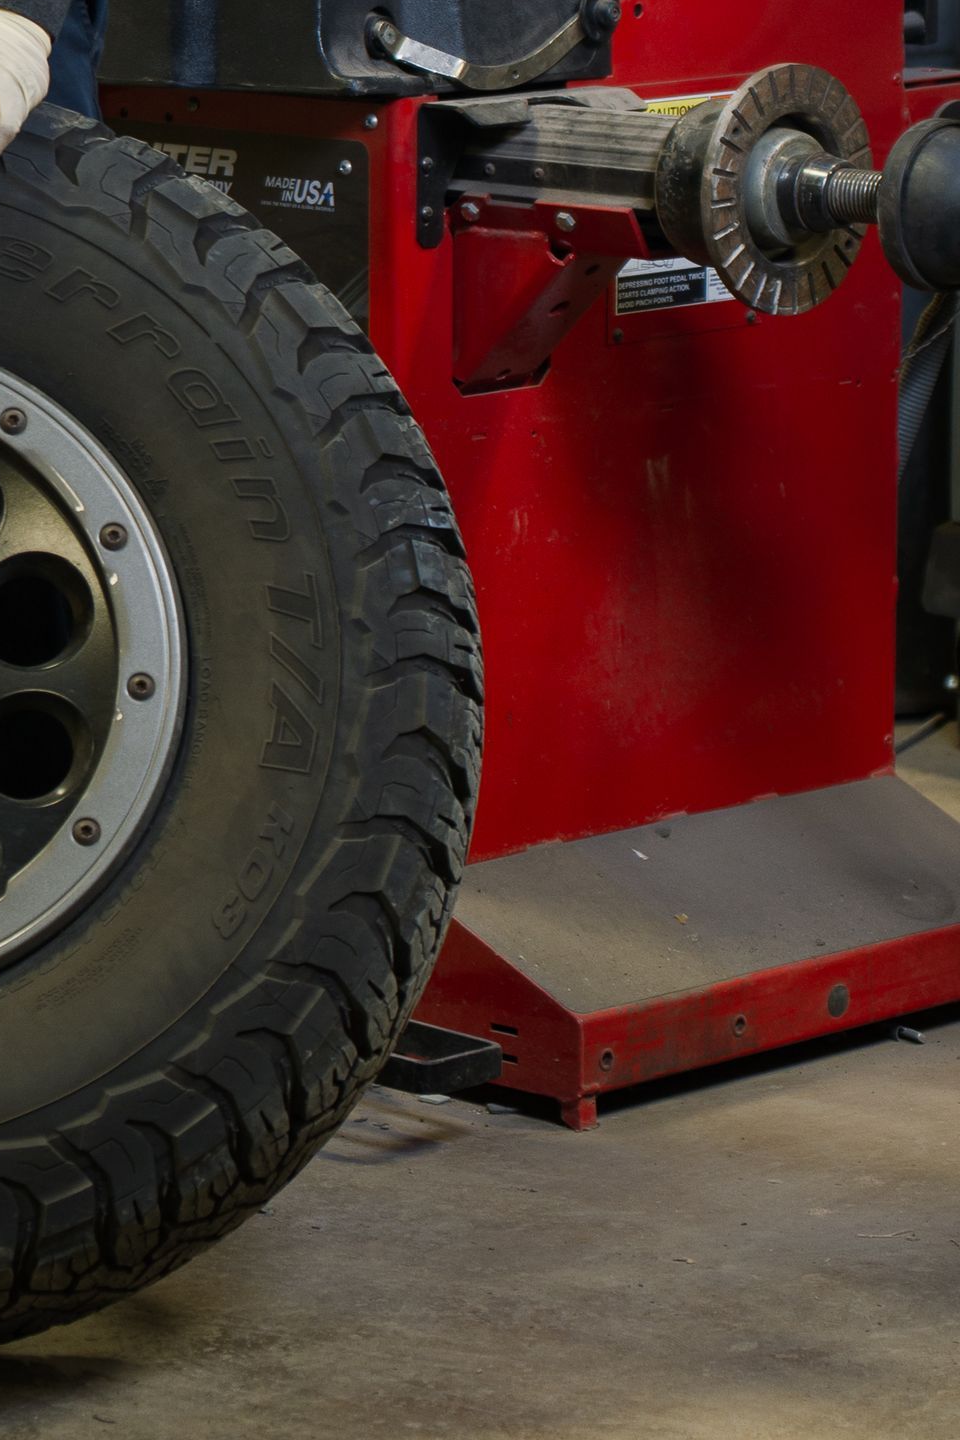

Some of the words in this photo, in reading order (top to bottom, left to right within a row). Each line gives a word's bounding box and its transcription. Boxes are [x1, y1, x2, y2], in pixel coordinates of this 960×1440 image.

[649, 104, 694, 117] AUTIO
[265, 176, 296, 189] MADE
[282, 190, 294, 202] IN
[293, 179, 335, 207] USA
[618, 279, 653, 290] DEPRESSING
[653, 277, 669, 286] FOOT
[669, 274, 687, 284] PEDAL
[688, 272, 705, 281] TWICE
[618, 290, 639, 300] STARTS
[640, 287, 670, 297] CLAMPING
[618, 300, 635, 309] AVOID
[635, 298, 652, 307] PINCH
[258, 571, 324, 774] T/A
